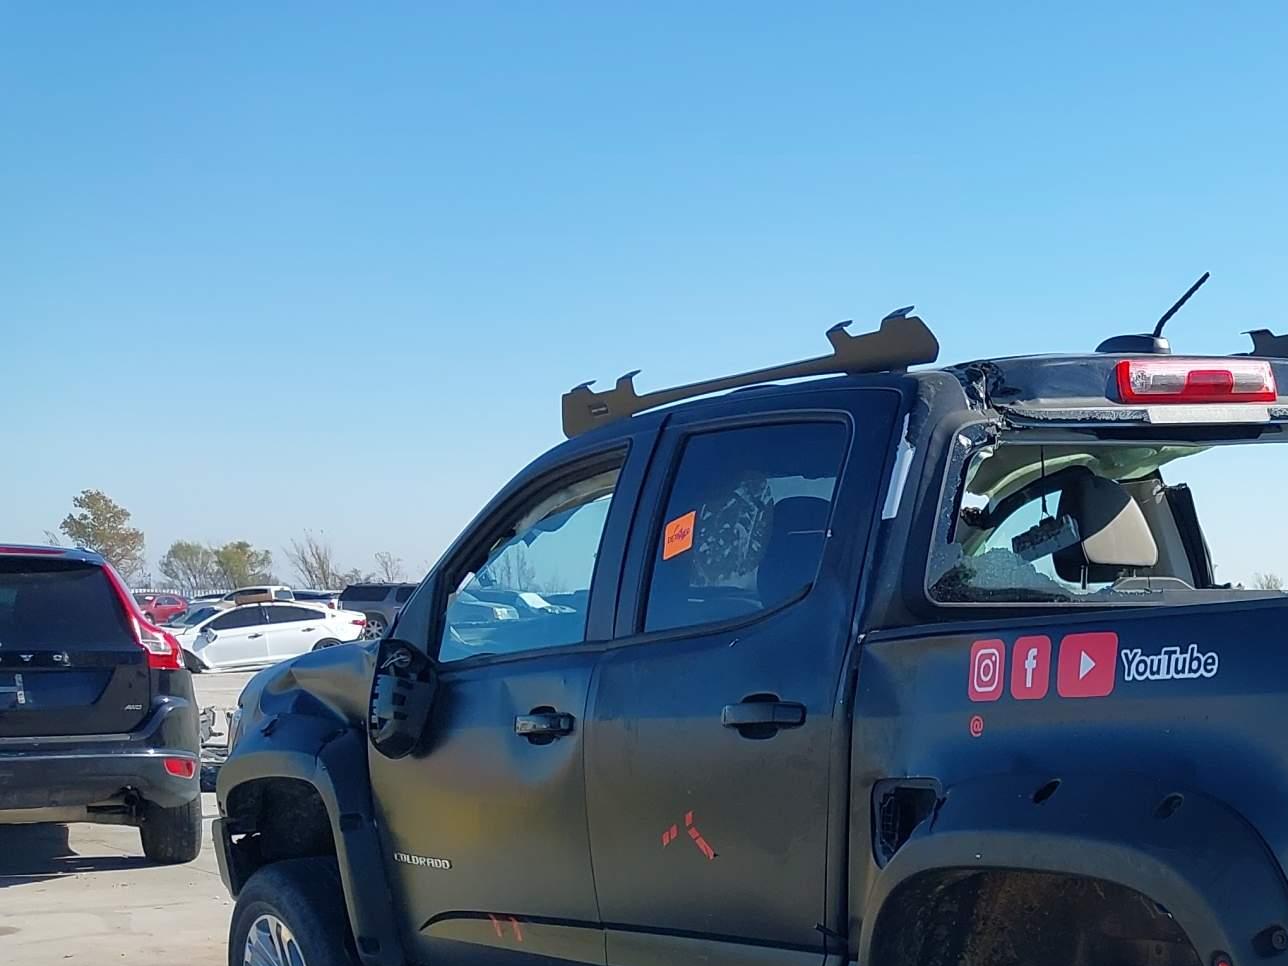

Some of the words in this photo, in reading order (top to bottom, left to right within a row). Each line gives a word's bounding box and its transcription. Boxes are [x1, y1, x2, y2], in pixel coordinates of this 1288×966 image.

[1120, 643, 1219, 681] YouTube
[969, 715, 985, 737] @
[393, 851, 452, 871] COLORADO
